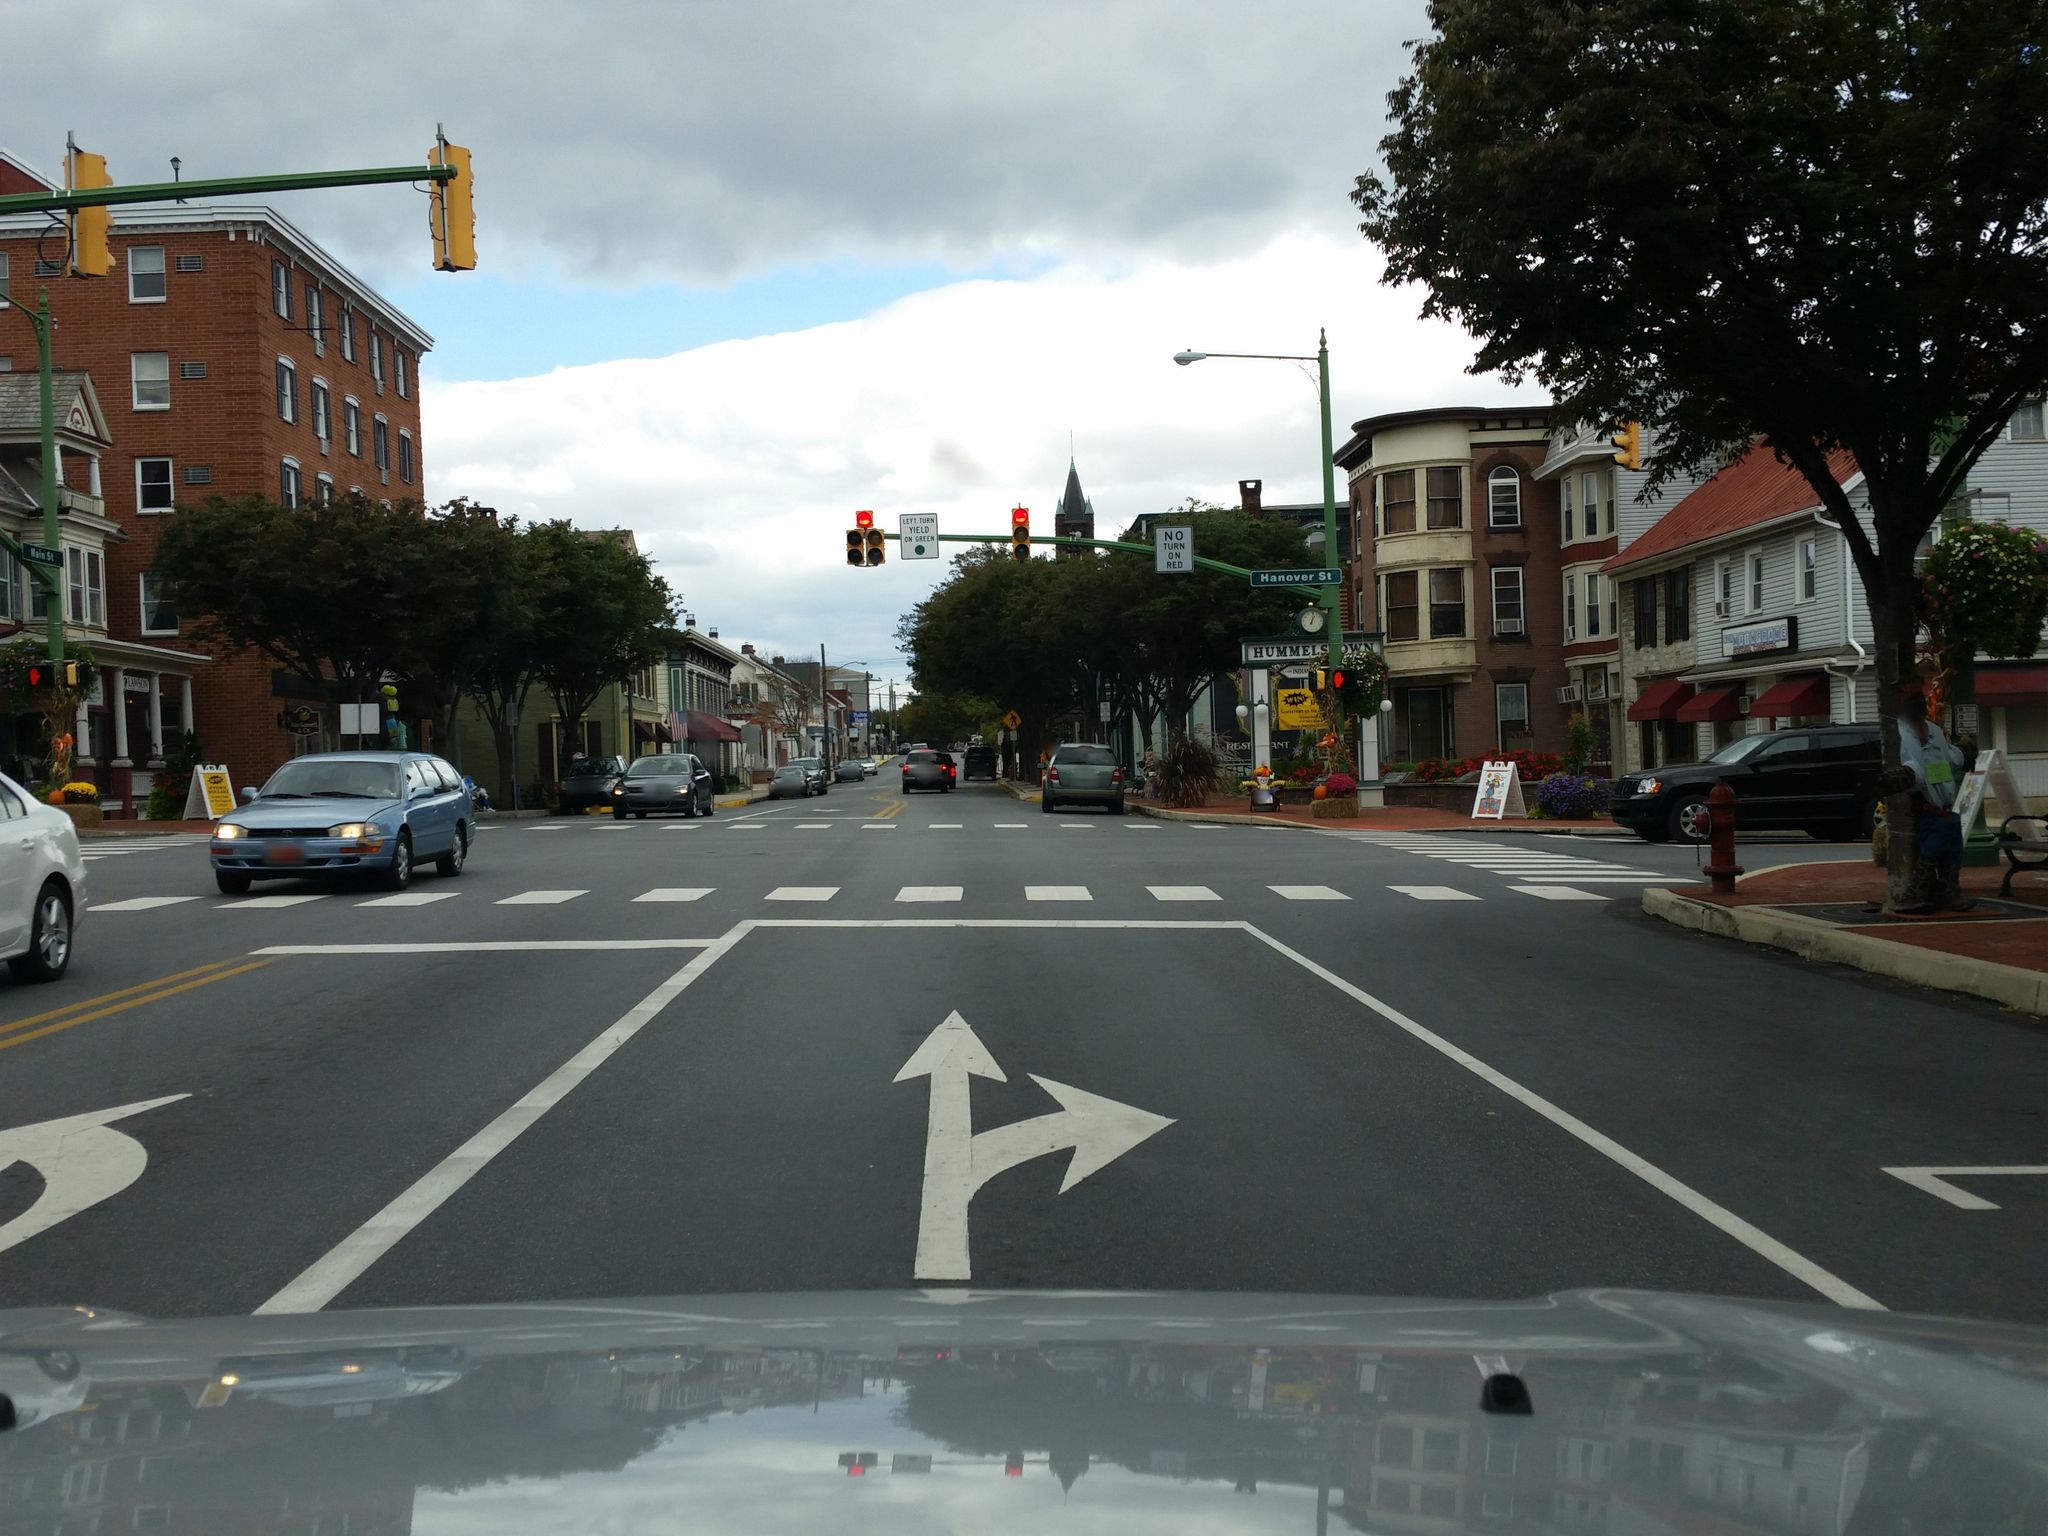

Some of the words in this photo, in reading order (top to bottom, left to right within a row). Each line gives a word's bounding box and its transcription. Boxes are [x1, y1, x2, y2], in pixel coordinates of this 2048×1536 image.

[902, 517, 916, 525] LEFT
[909, 526, 930, 534] YIELD
[1164, 530, 1184, 541] NO
[1164, 542, 1185, 551] TURN
[30, 547, 45, 560] Main
[46, 551, 55, 562] St
[1166, 561, 1183, 569] RED
[1260, 573, 1315, 582] Hanover
[1318, 571, 1332, 581] St
[1253, 643, 1374, 658] HUMMELSOWN
[1226, 741, 1290, 751] RESTANT
